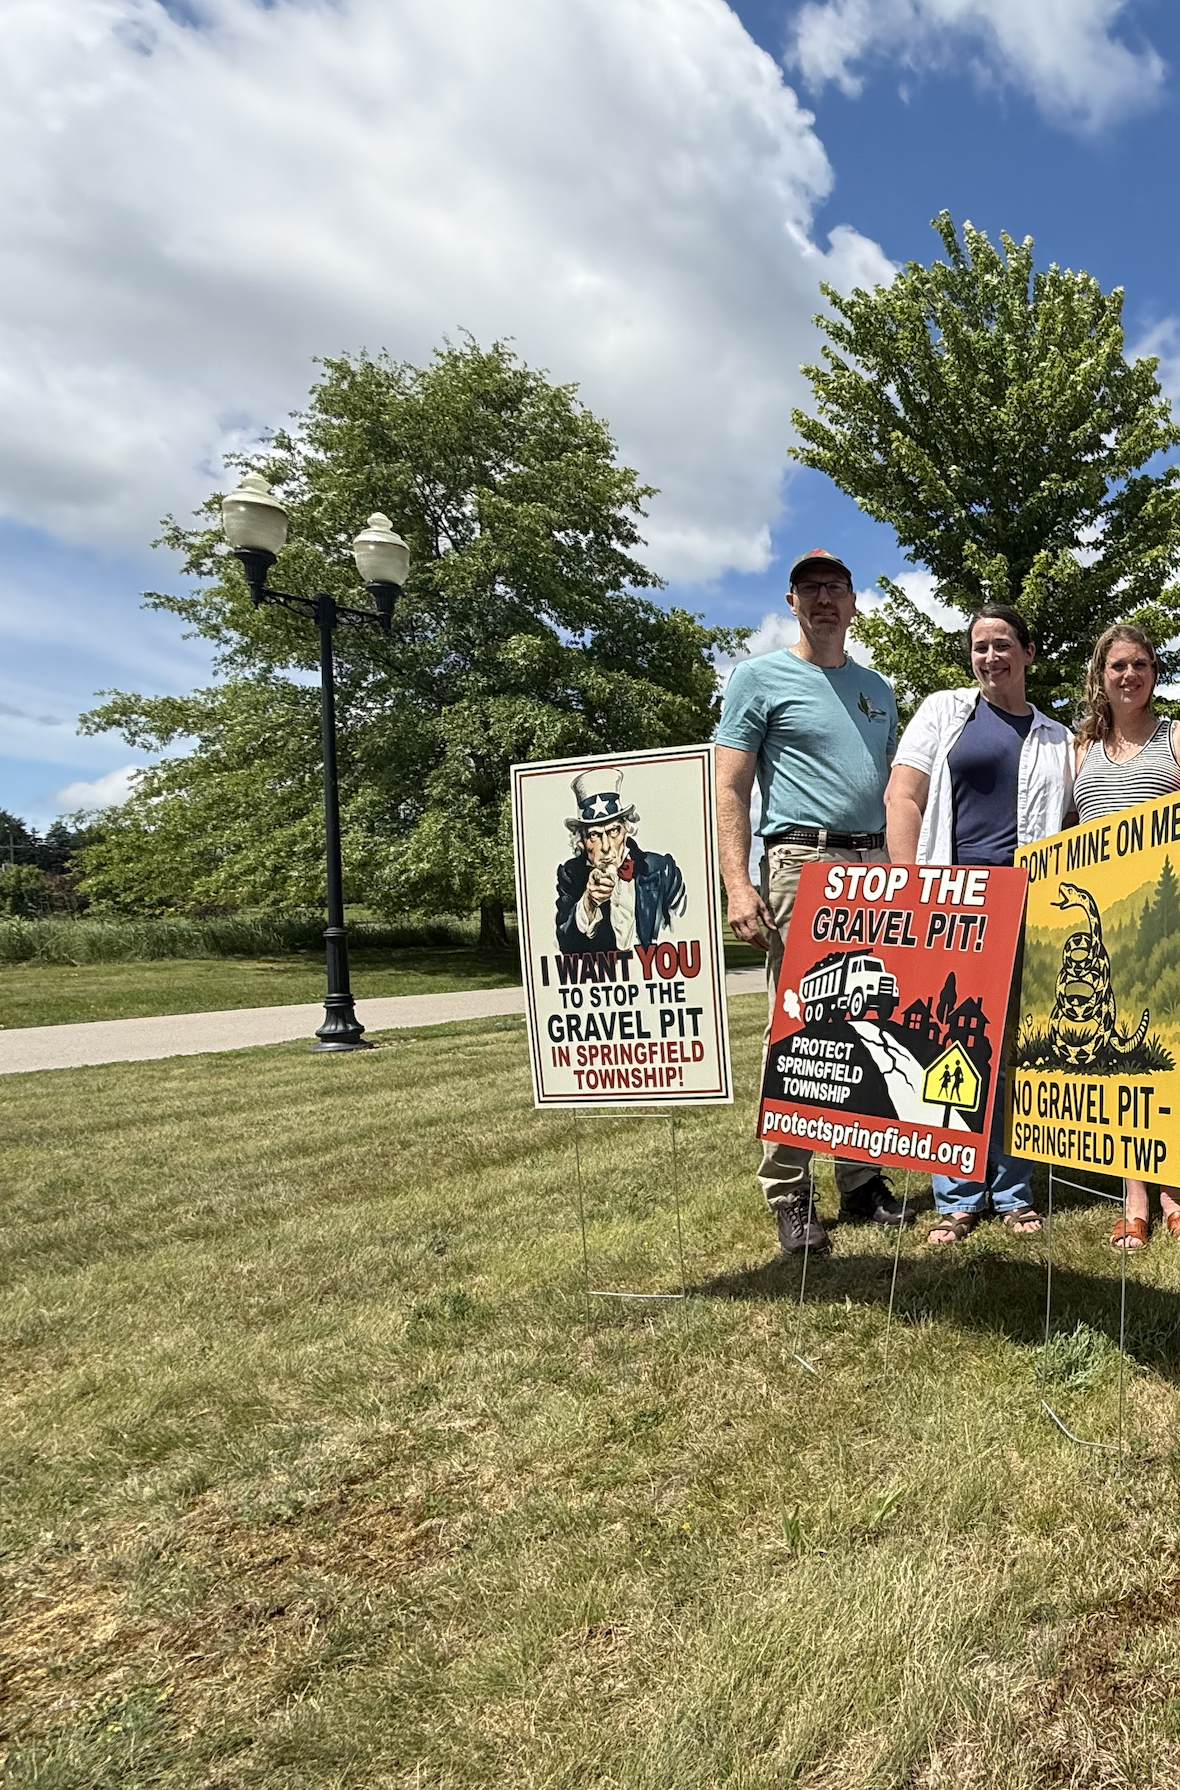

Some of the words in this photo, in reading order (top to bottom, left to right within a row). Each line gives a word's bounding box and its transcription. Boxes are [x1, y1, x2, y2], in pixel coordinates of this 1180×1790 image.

[1066, 825, 1111, 873] MINE
[1116, 814, 1144, 855] ON
[824, 866, 908, 902] STOP
[918, 868, 989, 906] THE
[812, 906, 918, 947] GRAVEL
[925, 912, 988, 953] PIT!
[541, 955, 550, 986] I
[555, 950, 633, 985] WANT
[634, 940, 702, 981] YOU
[559, 987, 584, 1009] TO
[590, 984, 639, 1007] STOP
[646, 981, 685, 1004] THE
[547, 1010, 650, 1043] GRAVEL
[659, 1007, 703, 1038] PIT
[551, 1044, 570, 1068] IN
[576, 1040, 705, 1067] SPRINGFIELD
[791, 1036, 854, 1062] PROTECT
[573, 1067, 684, 1090] TOWNSHIP!
[776, 1055, 863, 1085] SPRINGFIELD
[782, 1076, 850, 1105] TOWNSHIP
[1011, 1079, 1032, 1116] NO
[1037, 1080, 1110, 1125] GRAVEL
[762, 1109, 976, 1174] protectspringfield.org
[1015, 1121, 1114, 1166] SPRINGFIELD
[1120, 1135, 1167, 1174] TWP
